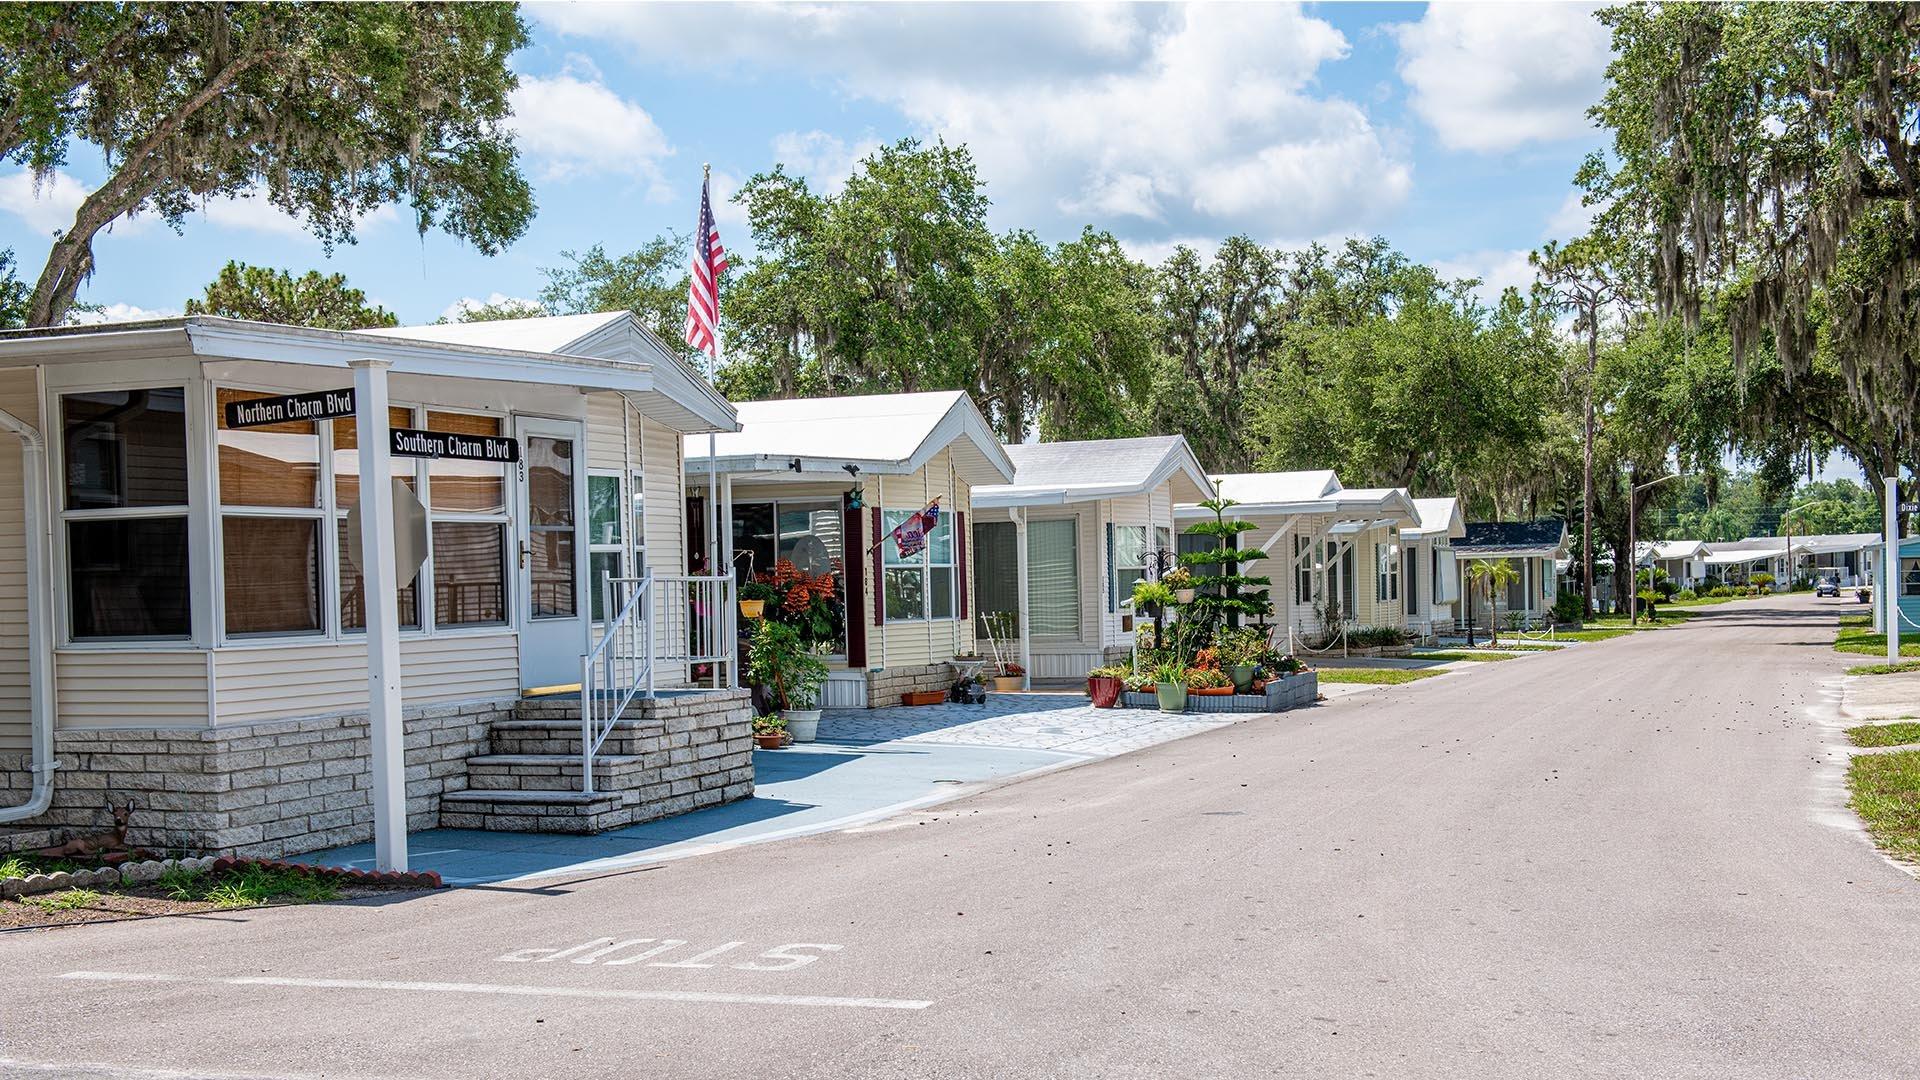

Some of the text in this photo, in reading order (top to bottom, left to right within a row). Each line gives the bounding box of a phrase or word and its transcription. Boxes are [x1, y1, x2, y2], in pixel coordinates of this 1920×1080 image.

[236, 392, 352, 424] Northern Charm Blvd
[395, 431, 510, 459] Southern Charm Blvd
[493, 936, 845, 971] STOP
